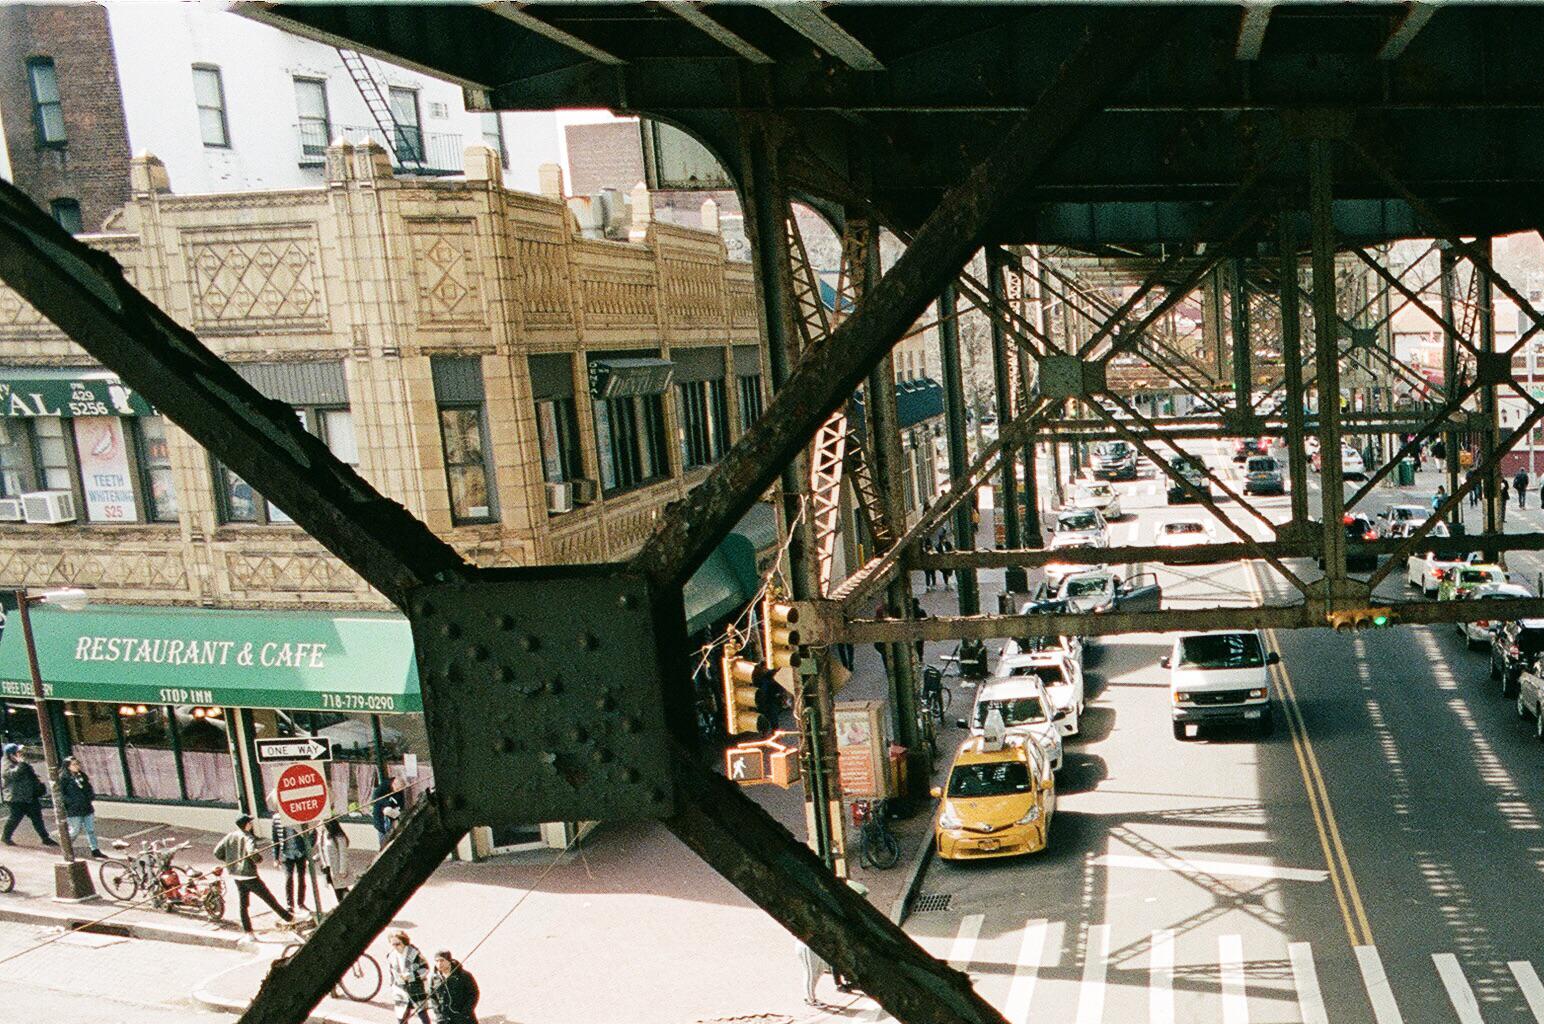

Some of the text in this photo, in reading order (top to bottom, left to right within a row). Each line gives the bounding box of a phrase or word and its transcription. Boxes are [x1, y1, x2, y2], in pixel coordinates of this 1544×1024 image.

[72, 391, 95, 401] 429
[68, 402, 109, 416] 5256
[93, 474, 124, 487] TEETH
[75, 636, 327, 669] RESTAURANT & CAFE
[160, 688, 212, 704] STOP INN
[322, 693, 394, 710] 718-779-0290
[267, 745, 320, 756] ONE WAY
[283, 773, 317, 788] DO NOT
[289, 799, 319, 813] ENTER
